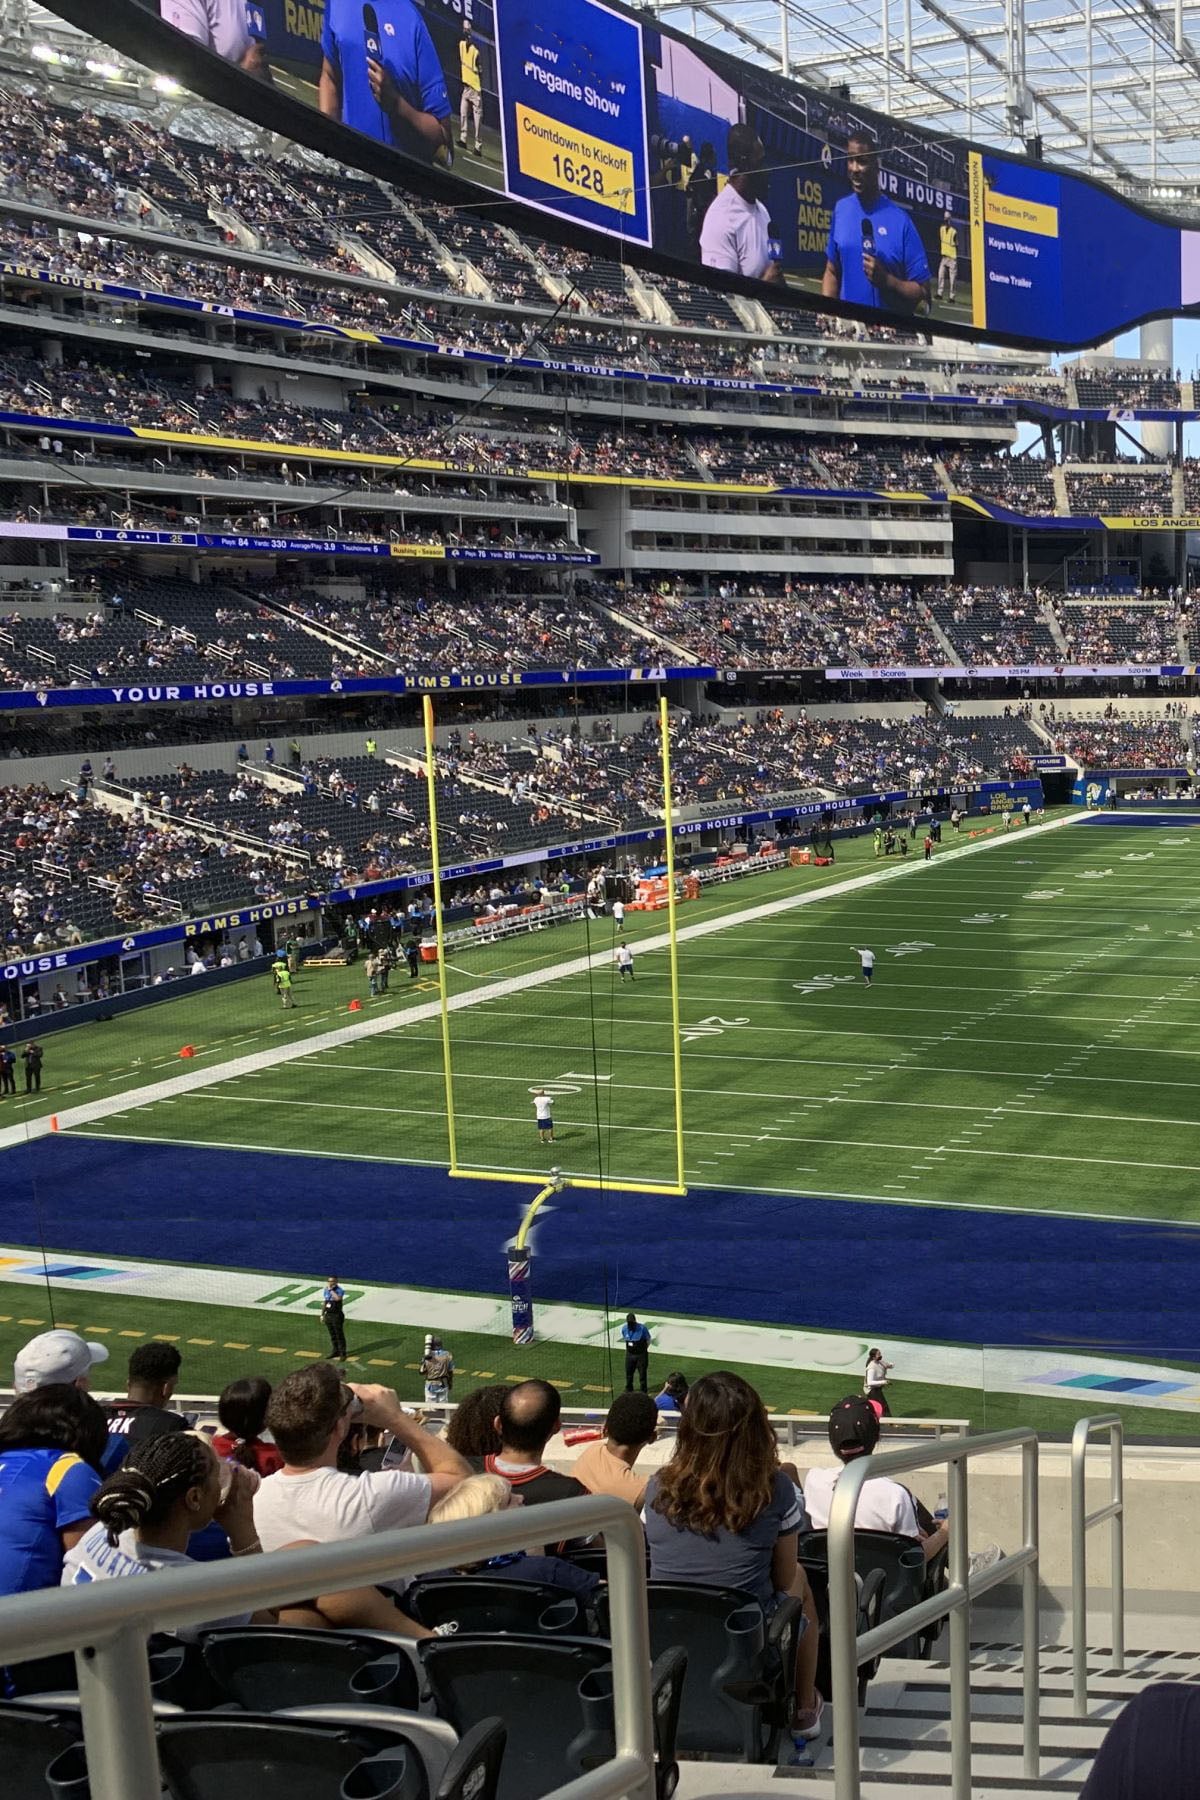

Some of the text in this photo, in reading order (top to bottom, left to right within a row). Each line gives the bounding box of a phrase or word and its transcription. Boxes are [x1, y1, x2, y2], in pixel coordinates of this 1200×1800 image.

[584, 86, 620, 118] Show
[523, 117, 627, 173] Countdown to Kickoff
[553, 153, 604, 197] 16:28
[796, 177, 822, 204] LOS
[879, 170, 954, 211] UR HOUSE
[988, 203, 1038, 222] The Game Plan
[988, 237, 1039, 258] Keys to Victory
[2, 264, 103, 292] AMS HOUSE
[989, 272, 1032, 289] Game Trailer
[201, 302, 235, 317] LA
[543, 361, 616, 377] OUR HOUSE
[675, 376, 757, 390] YOUR HOUSE
[820, 388, 902, 400] RAMS HOUSE
[1106, 408, 1135, 421] LA
[1133, 519, 1159, 528] LOS
[95, 530, 103, 539] 0
[238, 537, 249, 546] 84
[271, 540, 287, 549] 330
[324, 542, 336, 551] 3.9
[393, 547, 418, 557] Rushing
[422, 548, 444, 557] Season
[504, 551, 515, 560] 251
[461, 673, 522, 687] HOUSE
[840, 669, 907, 678] Week Scores
[112, 683, 275, 702] YOUR HOUSE
[679, 785, 981, 835] OUR HOUSE YOUR HOUSE RAMS HOUSE
[186, 899, 310, 937] RAMS HOUSE
[3, 953, 68, 980] OUSE
[793, 973, 856, 992] 30
[678, 1014, 751, 1037] 20
[106, 1417, 136, 1434] RK
